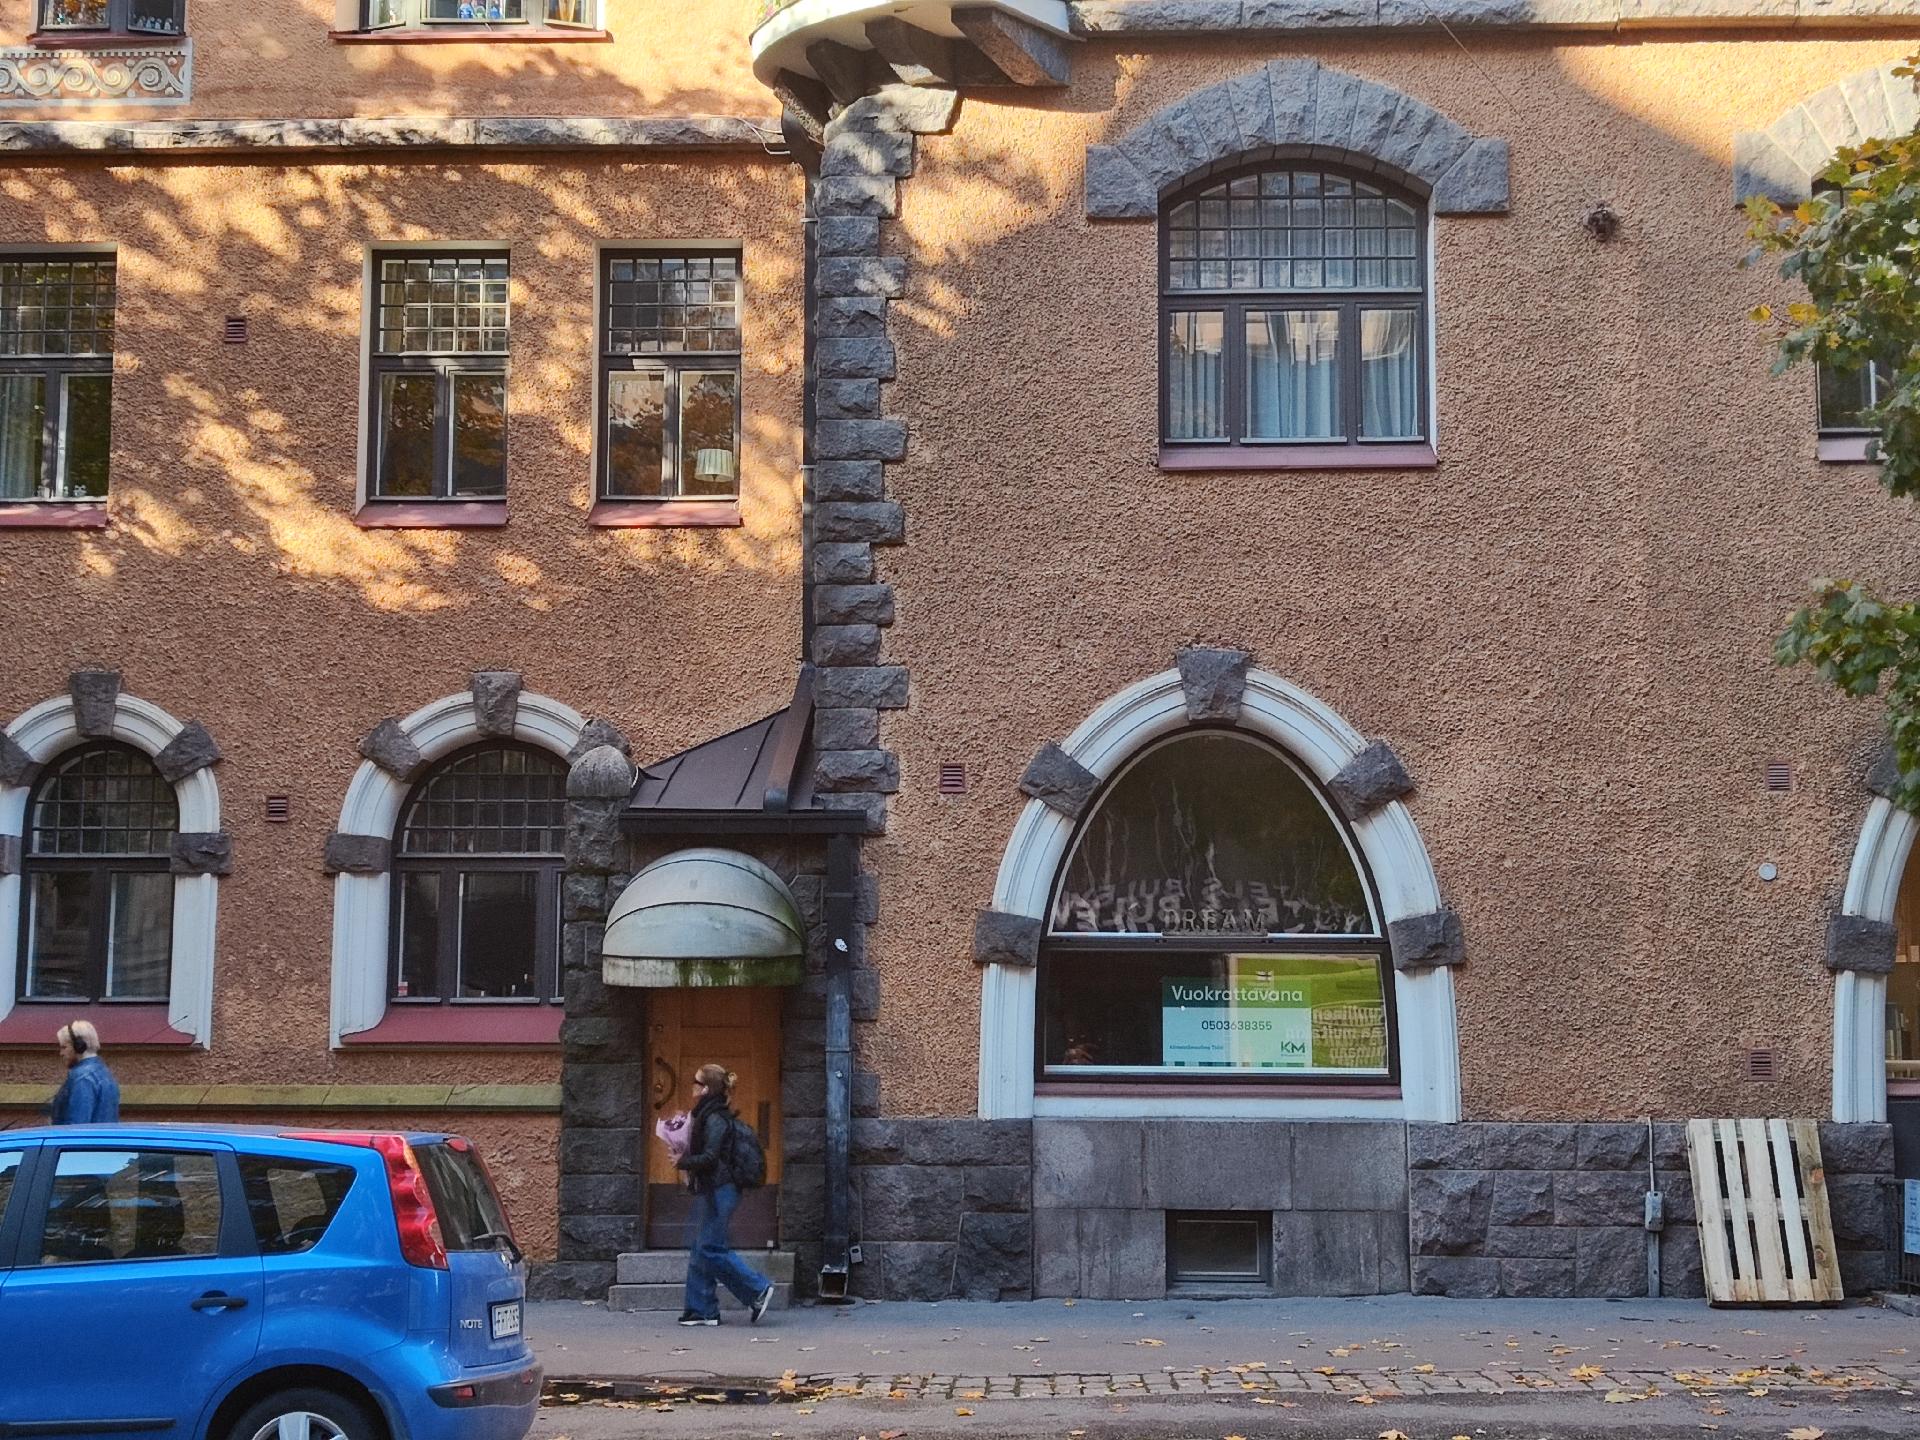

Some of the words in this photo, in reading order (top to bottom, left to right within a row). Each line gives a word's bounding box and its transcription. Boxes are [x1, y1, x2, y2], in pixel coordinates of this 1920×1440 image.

[1160, 908, 1267, 932] DREAM
[1171, 985, 1303, 1002] Vuokrattavana
[1201, 1020, 1273, 1031] 0503638355
[1280, 1040, 1306, 1053] KM
[459, 1319, 483, 1330] NOTE
